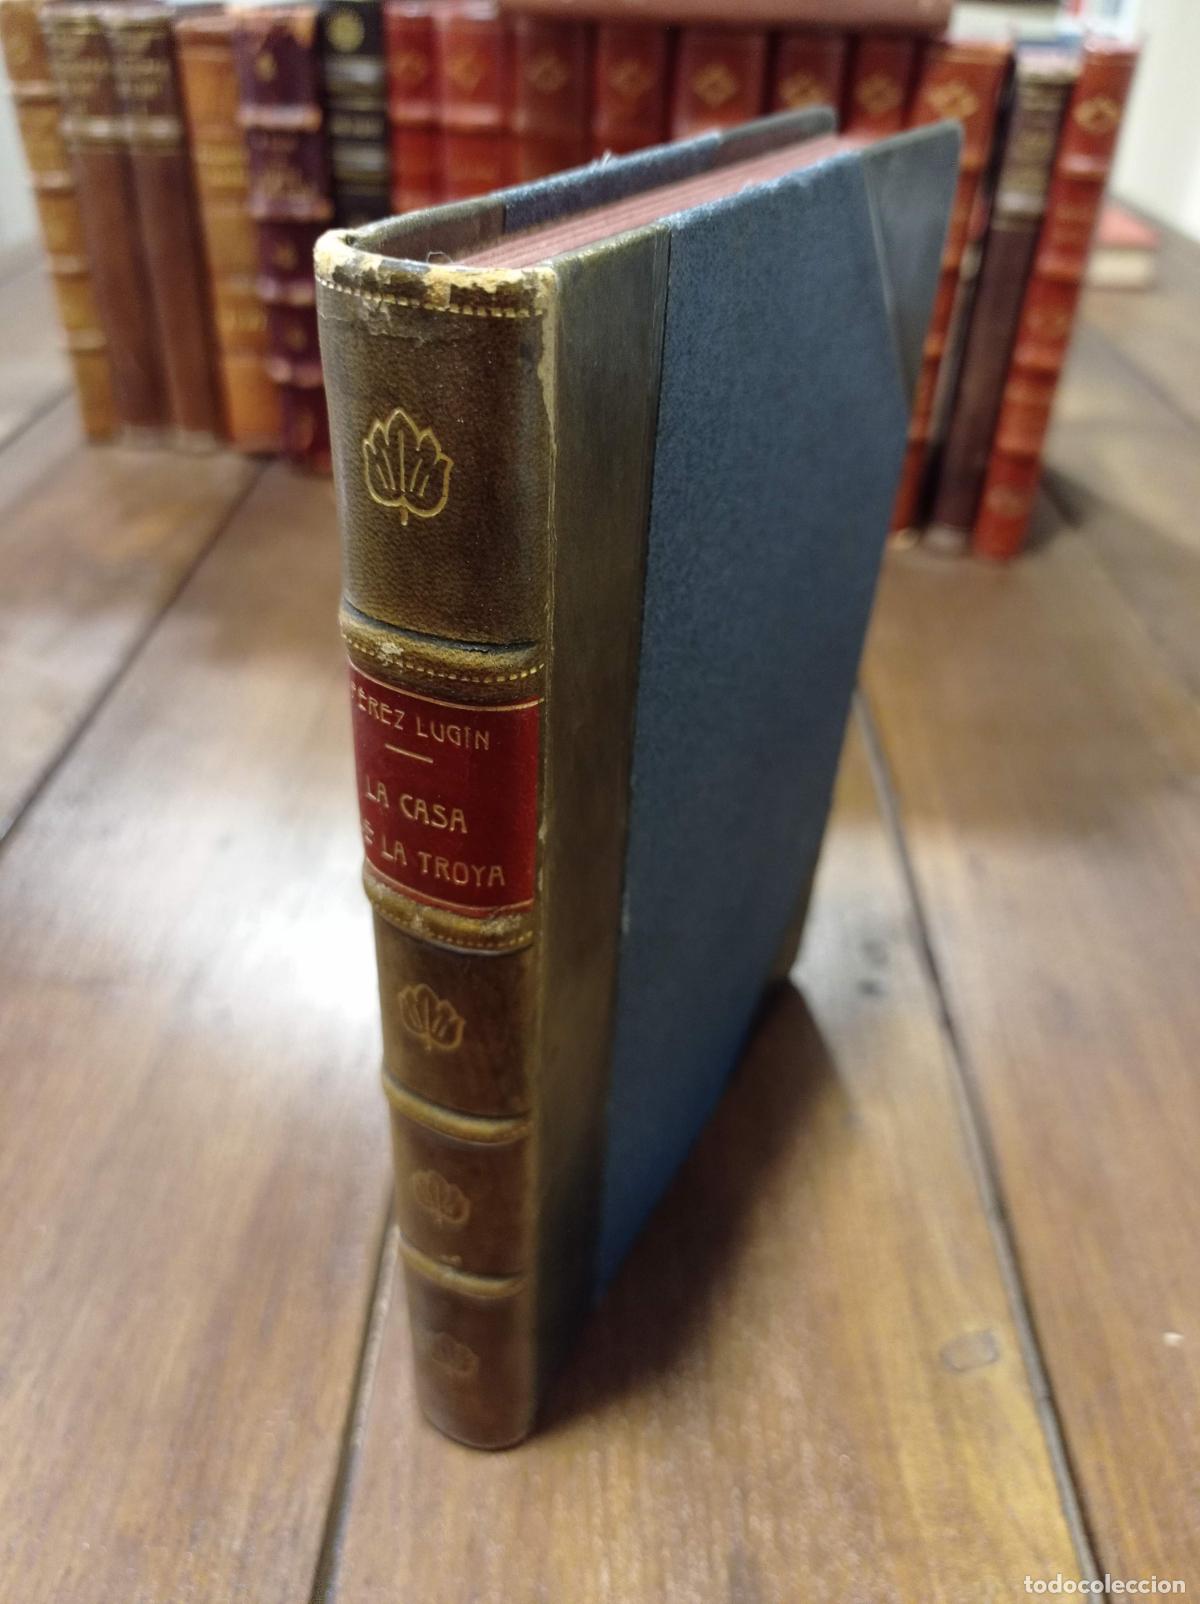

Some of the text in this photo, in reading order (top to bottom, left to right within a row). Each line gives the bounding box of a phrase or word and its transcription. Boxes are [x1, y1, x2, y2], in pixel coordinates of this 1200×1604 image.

[365, 775, 468, 834] LA CASA
[362, 818, 506, 887] E LA TROYA
